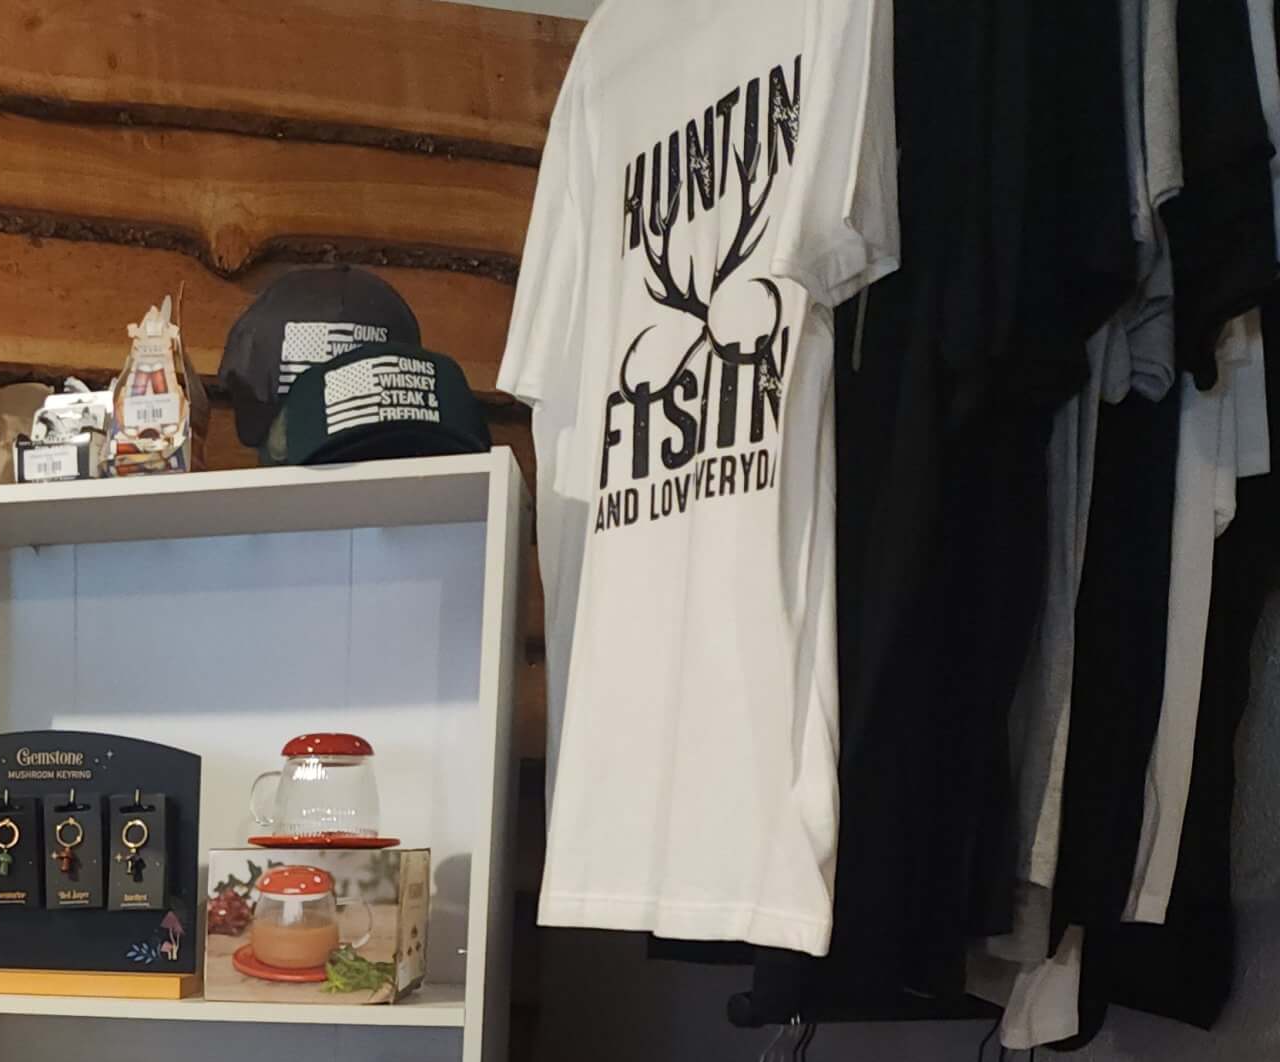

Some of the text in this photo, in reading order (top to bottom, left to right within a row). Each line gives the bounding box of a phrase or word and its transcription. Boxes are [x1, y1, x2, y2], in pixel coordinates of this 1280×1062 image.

[353, 325, 389, 342] GUNS
[399, 356, 436, 376] GUNS
[380, 373, 437, 391] WHISKEY
[381, 390, 439, 408] STEAK &
[379, 406, 440, 424] FREEDOM
[594, 488, 639, 534] AND
[16, 747, 84, 766] Gemstone
[8, 770, 93, 780] MUSHROOM KEYRING
